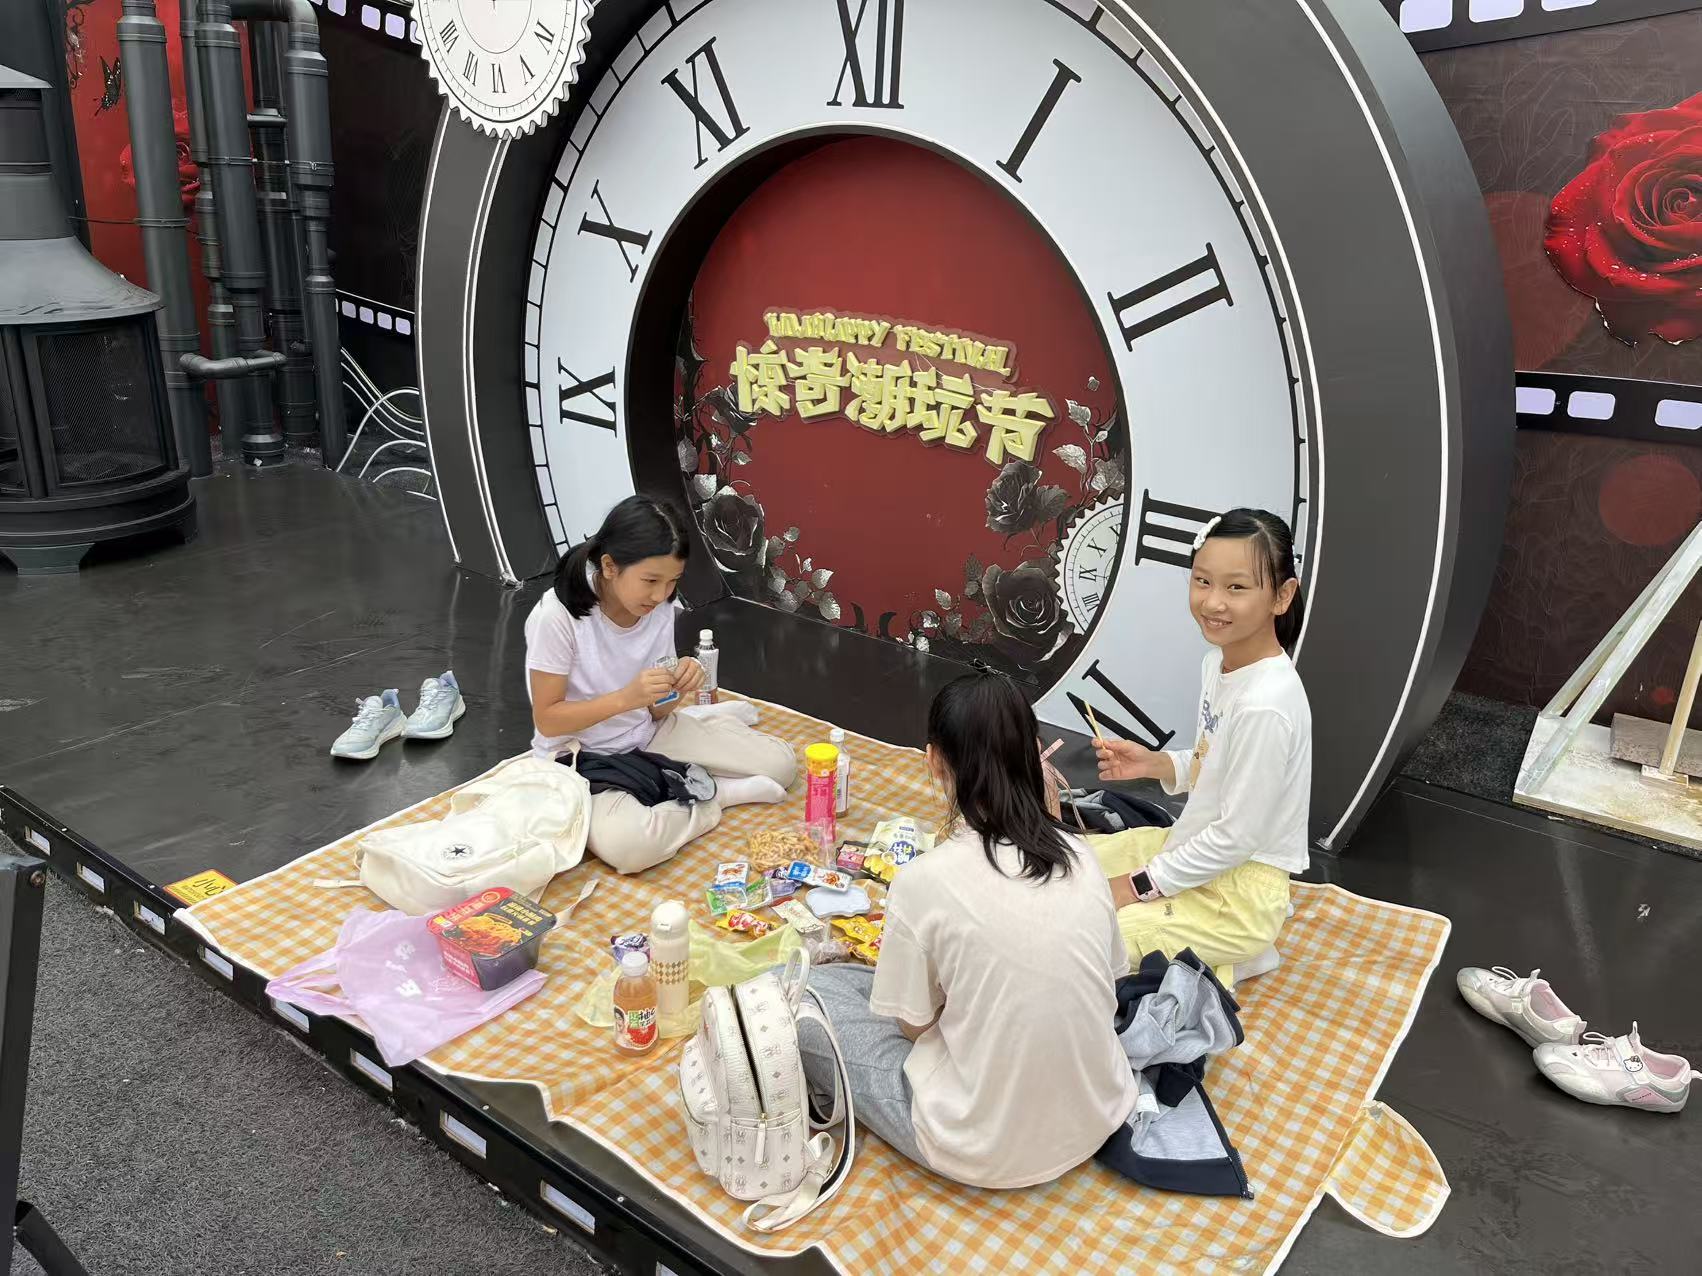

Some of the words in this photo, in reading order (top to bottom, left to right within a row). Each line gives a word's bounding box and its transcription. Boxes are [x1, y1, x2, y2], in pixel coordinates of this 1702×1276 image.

[661, 37, 750, 169] XI
[827, 0, 904, 109] XII
[996, 59, 1081, 183] I
[578, 179, 652, 283] X
[893, 324, 1012, 377] FESTIVAL
[1107, 243, 1233, 352] II
[558, 357, 617, 437] IX
[730, 341, 1055, 464] 惊奇潮玩节
